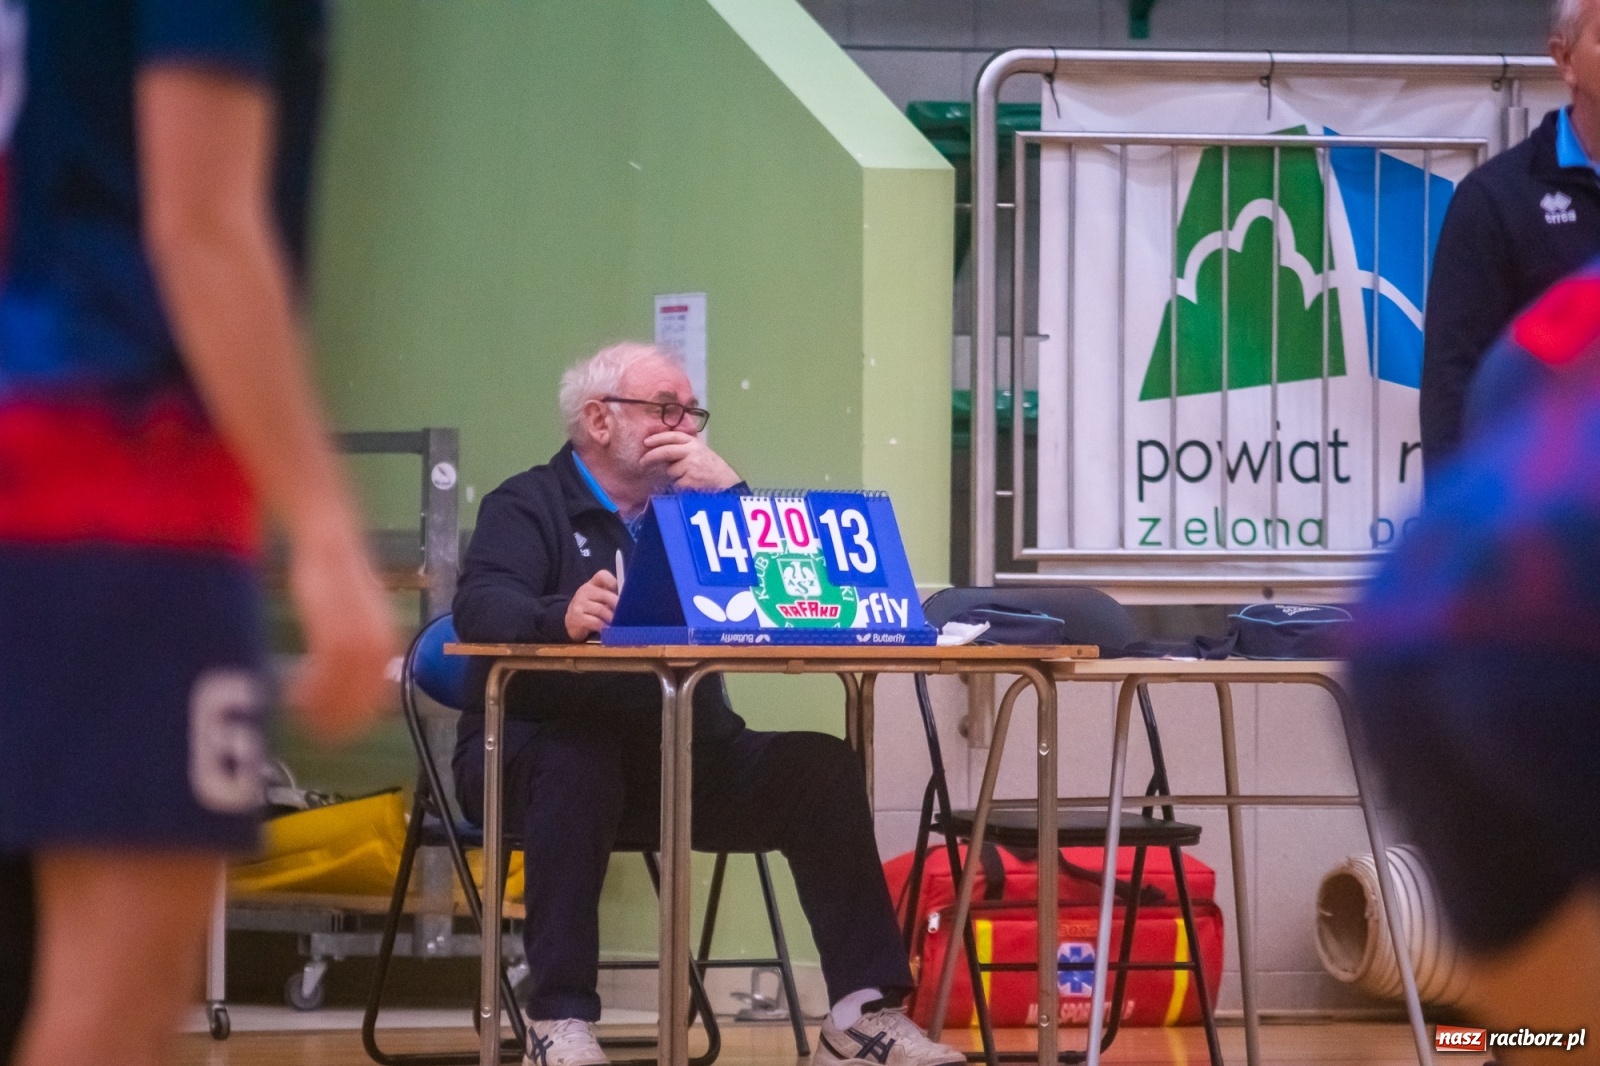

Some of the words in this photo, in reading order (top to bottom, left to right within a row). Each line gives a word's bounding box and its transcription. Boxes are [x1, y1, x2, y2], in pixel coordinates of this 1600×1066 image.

[1137, 420, 1350, 502] powiat
[690, 510, 748, 573] 14
[819, 508, 878, 575] 13
[1138, 506, 1325, 546] zelona
[777, 601, 839, 618] RAFAKO
[872, 633, 906, 643] Butterfly
[188, 666, 266, 812] 6
